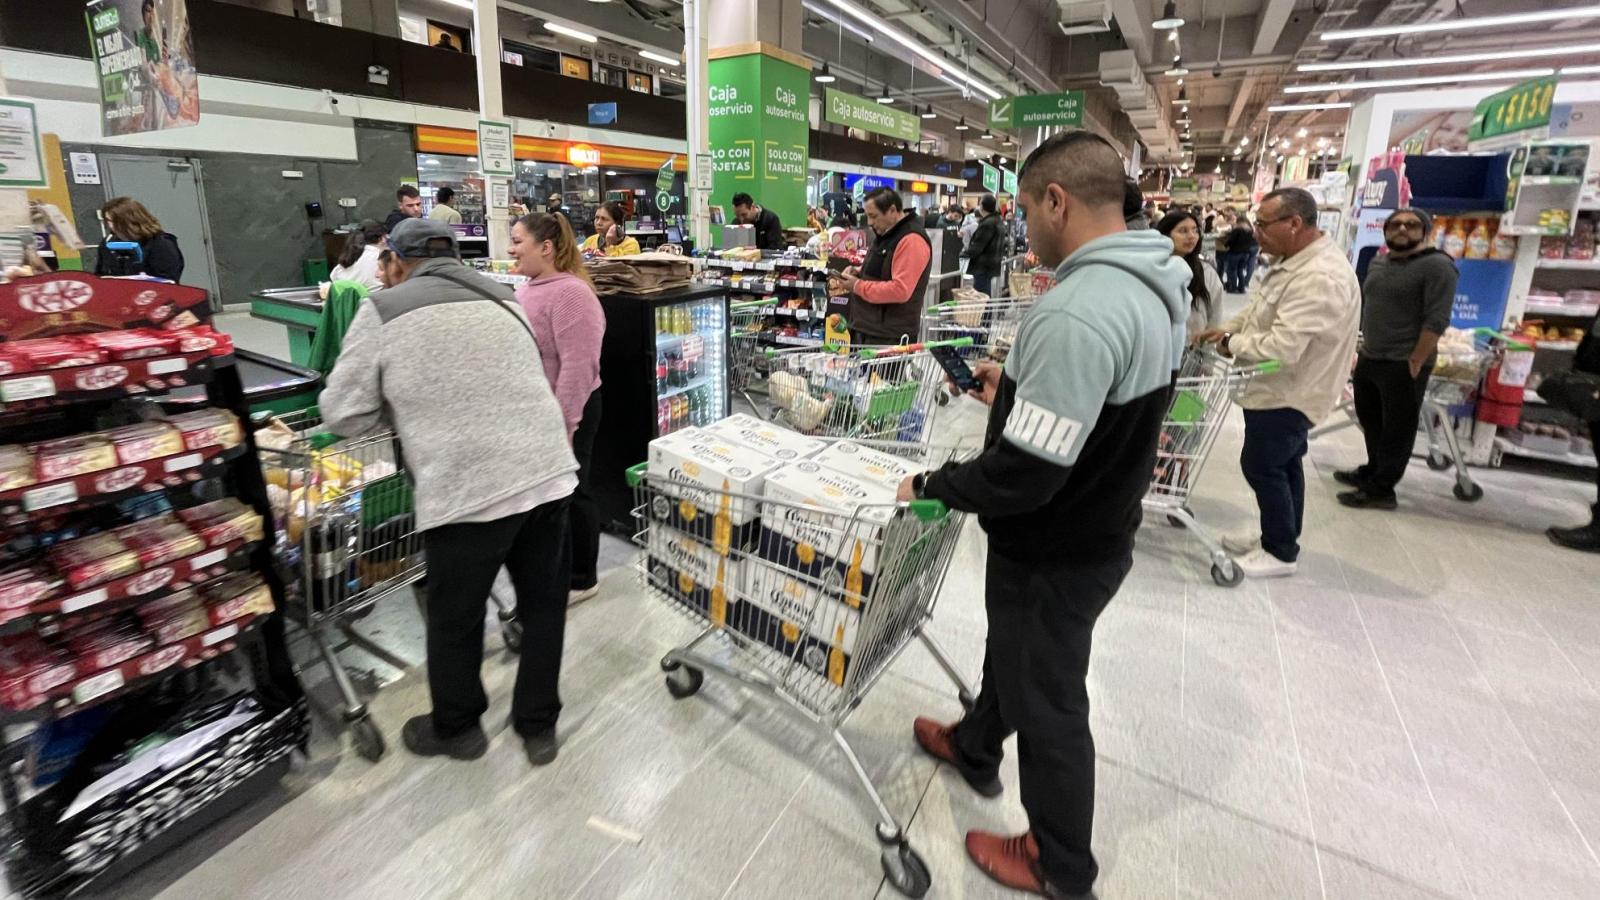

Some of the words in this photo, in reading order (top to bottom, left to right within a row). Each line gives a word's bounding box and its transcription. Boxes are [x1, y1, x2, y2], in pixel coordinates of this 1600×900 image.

[709, 84, 737, 104] Caja
[775, 85, 796, 107] Caja
[709, 102, 753, 116] oservicio
[1057, 98, 1077, 109] Caja
[765, 105, 805, 121] autoservicio
[833, 96, 850, 120] Caja
[852, 106, 895, 128] autoservicio
[1023, 111, 1077, 121] autoservicio
[711, 149, 725, 159] LO
[728, 148, 750, 158] CON
[768, 148, 788, 160] SOLO
[789, 151, 803, 162] CON
[711, 161, 751, 172] RJETAS
[767, 161, 803, 175] TARJETAS
[661, 196, 667, 206] 8
[1003, 396, 1083, 458] UMA
